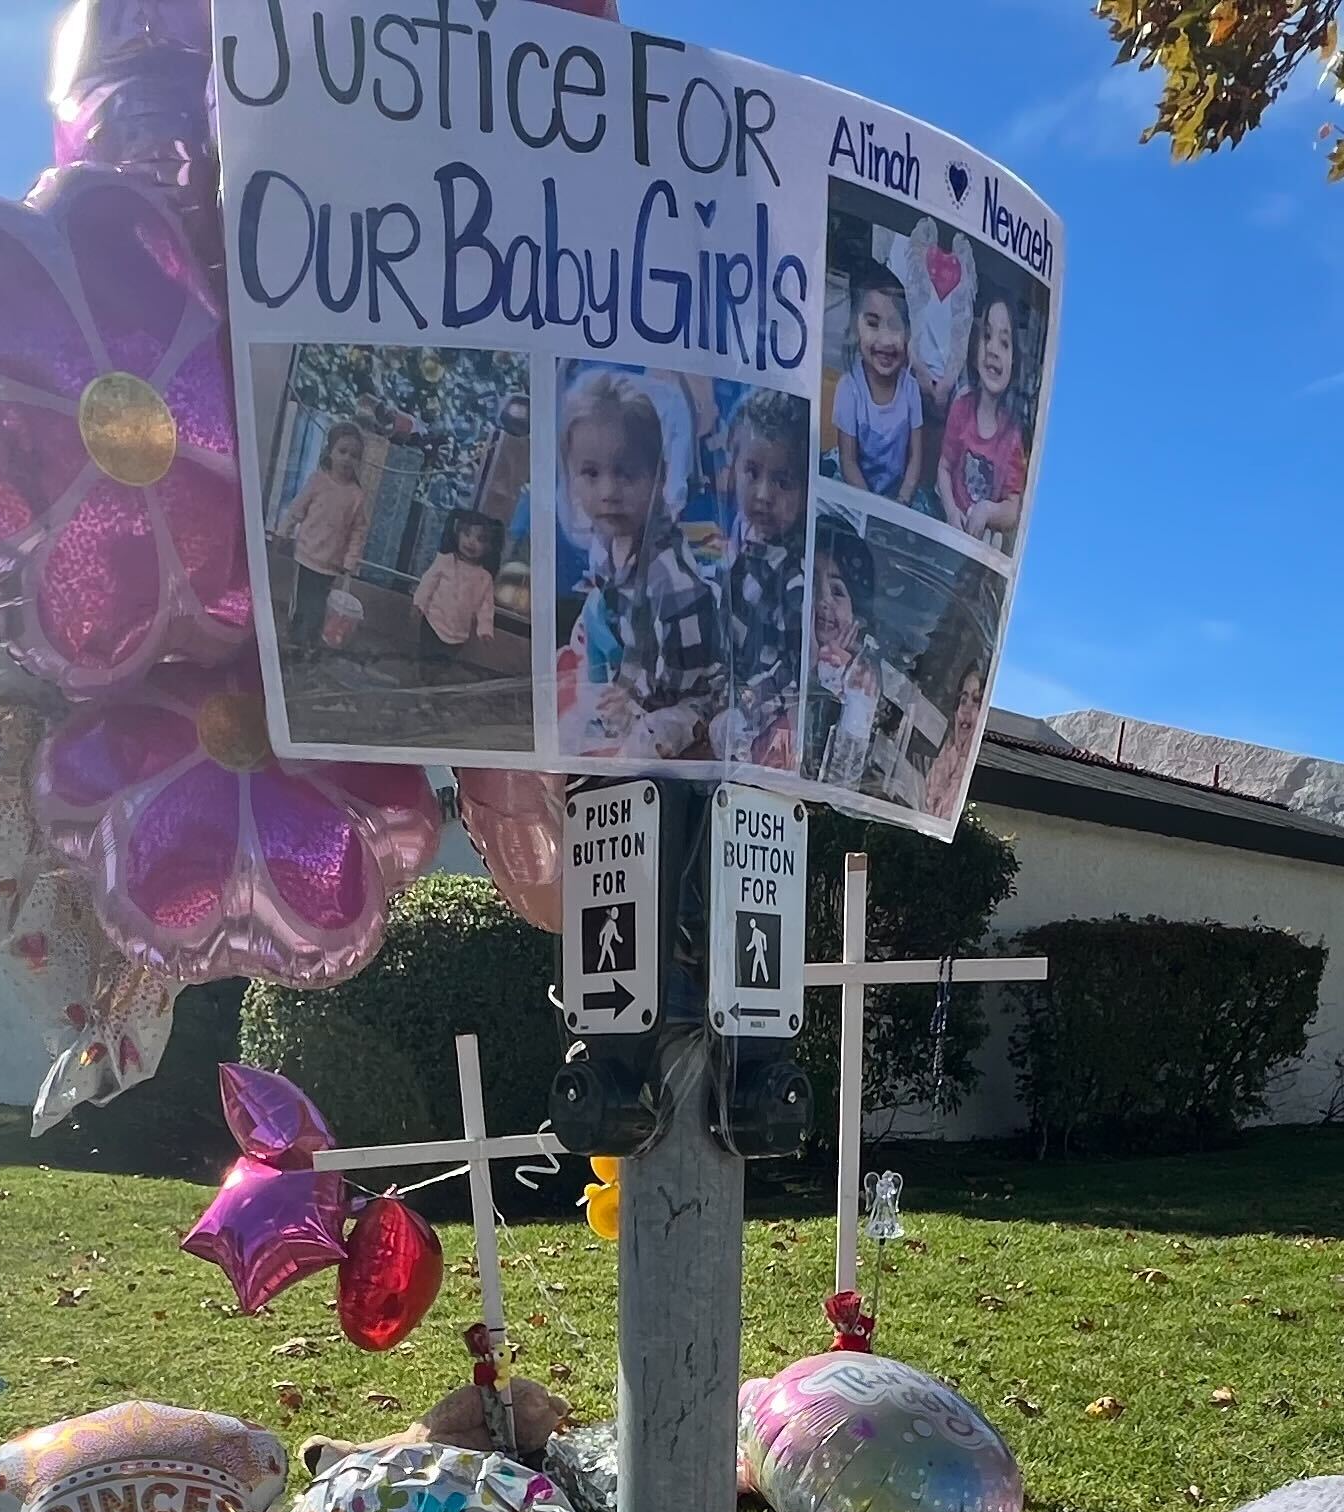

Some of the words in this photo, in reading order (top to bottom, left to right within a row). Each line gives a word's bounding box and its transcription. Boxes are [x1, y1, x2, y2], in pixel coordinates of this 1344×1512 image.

[222, 0, 606, 153] Justice
[631, 30, 782, 187] FOR
[828, 115, 920, 200] Alinah
[982, 176, 1054, 281] Nevaeh
[238, 169, 427, 330] OUR
[434, 162, 620, 349] Baby
[586, 798, 632, 831] PUSH
[735, 809, 785, 842] PUSH
[573, 832, 646, 867] BUTTON
[723, 841, 795, 876] BUTTON
[592, 870, 626, 897] FOR
[741, 877, 777, 906] FOR
